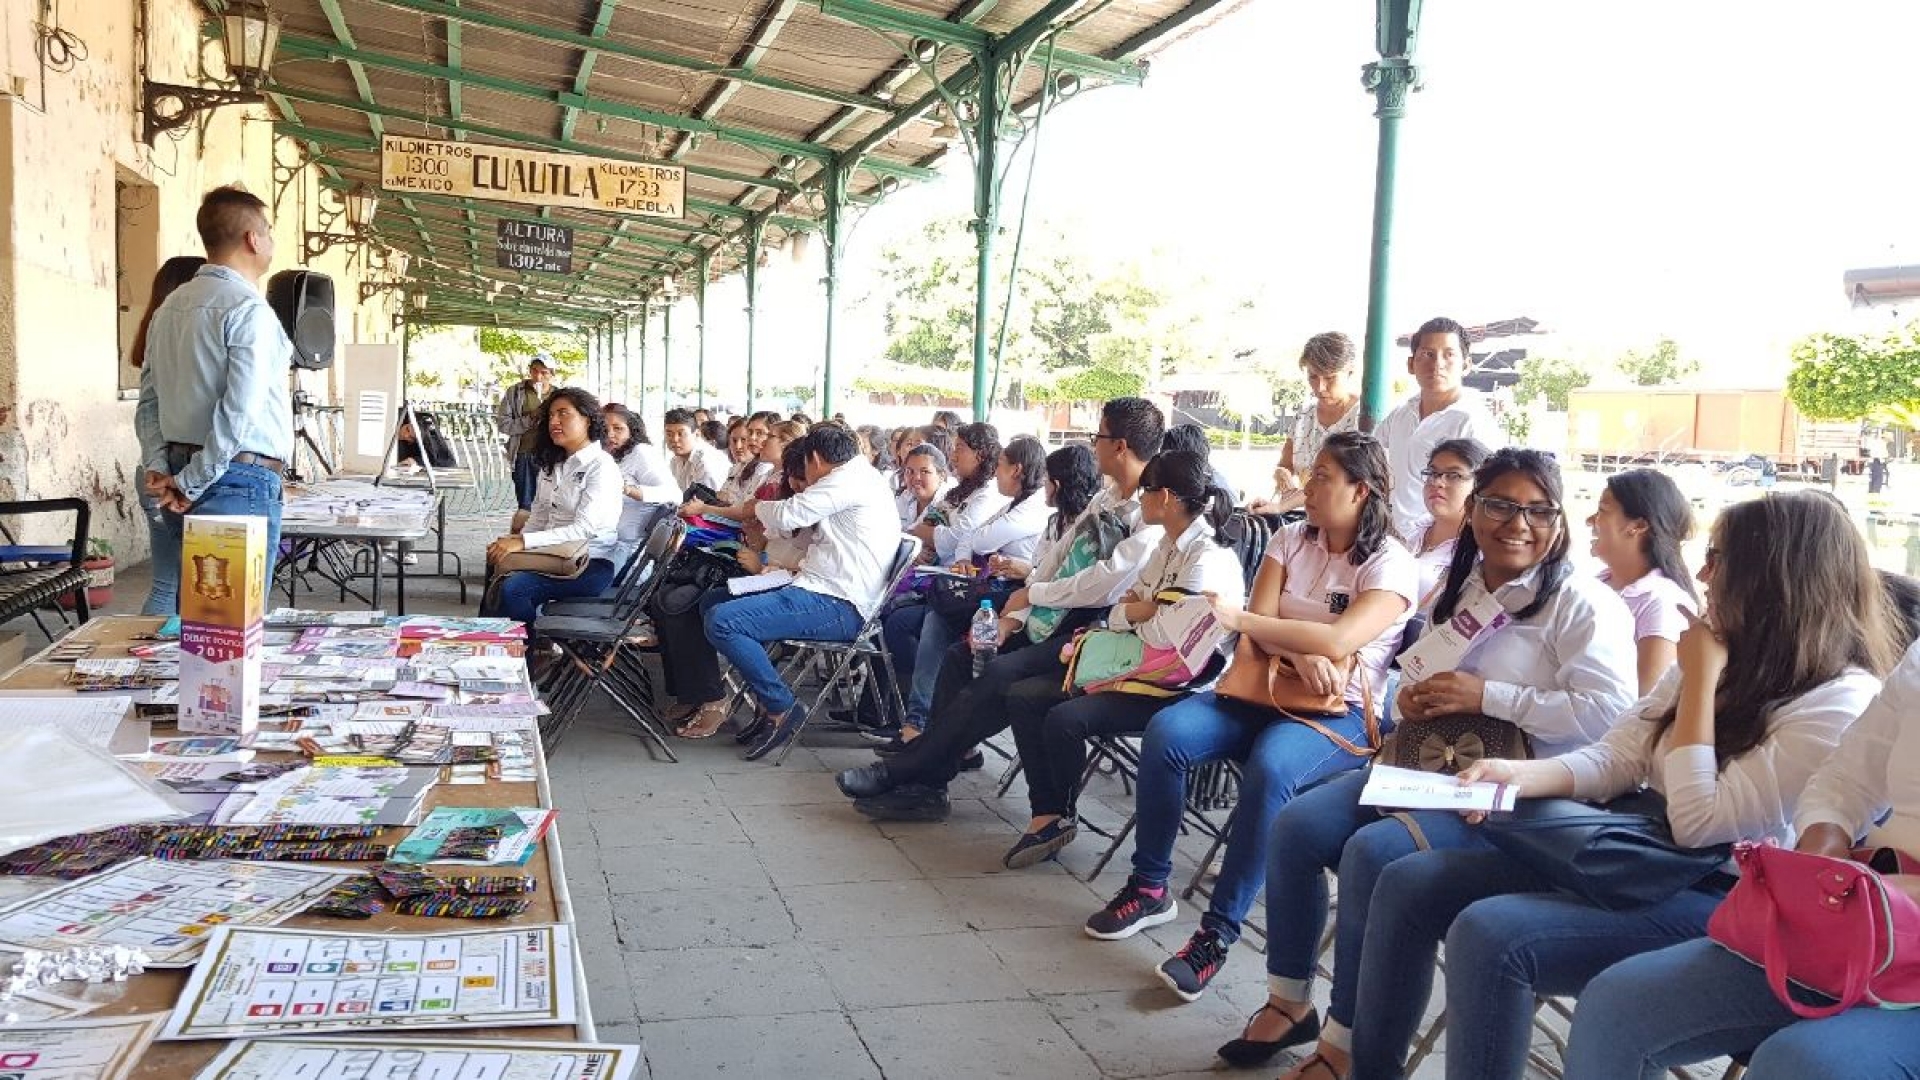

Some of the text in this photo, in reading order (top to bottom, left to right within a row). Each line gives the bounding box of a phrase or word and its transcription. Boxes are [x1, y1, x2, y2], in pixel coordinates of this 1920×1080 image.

[385, 140, 472, 158] KILOMETROS
[473, 154, 599, 200] CUAUTLA
[599, 162, 680, 181] KILOMETROS
[396, 176, 454, 191] MEXICO
[615, 197, 675, 215] PUEBLA
[504, 222, 566, 244] ALTURA
[527, 931, 538, 946] INE
[581, 1053, 601, 1076] INE
